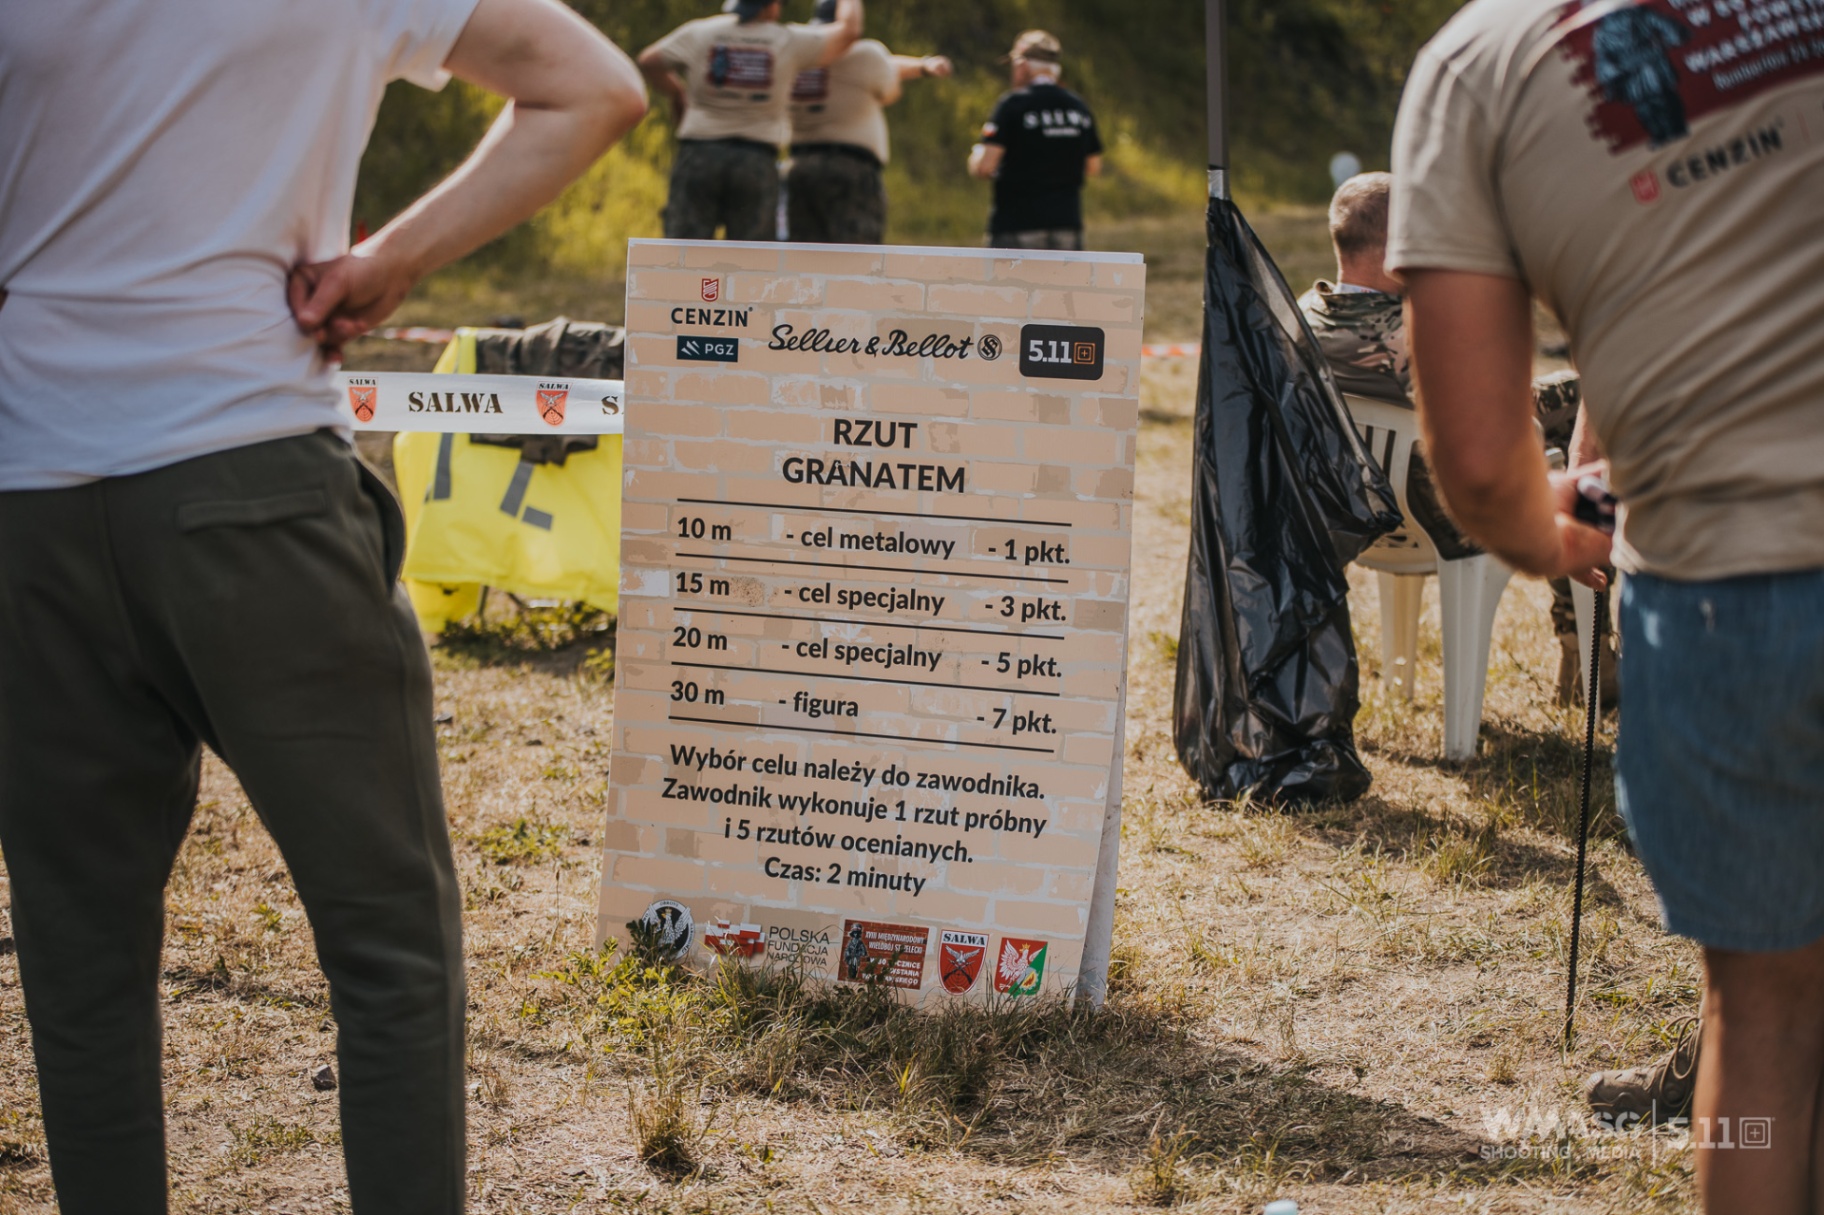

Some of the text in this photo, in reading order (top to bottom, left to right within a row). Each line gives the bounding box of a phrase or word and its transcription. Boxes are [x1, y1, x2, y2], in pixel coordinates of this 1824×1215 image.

[704, 343, 735, 356] PGZ
[767, 323, 975, 360] Sellier & Bellot
[1027, 339, 1073, 364] 5.11
[349, 378, 376, 386] SALWA
[538, 382, 570, 390] SALWA
[408, 391, 504, 414] SALWA
[833, 418, 918, 449] RZUT
[782, 456, 965, 494] GRANATEM
[677, 516, 706, 539] 10
[711, 524, 732, 541] m
[800, 526, 833, 548] cel
[839, 530, 956, 561] metalowy
[1004, 538, 1018, 561] 1
[1024, 540, 1070, 566] pkt.
[676, 571, 703, 594] 15
[709, 579, 730, 596] m
[798, 582, 831, 604] cel
[837, 586, 946, 617] specjalny
[1000, 595, 1015, 618] 3
[1021, 597, 1067, 623] pkt.
[672, 625, 702, 649] 20
[707, 633, 728, 651] m
[796, 637, 829, 659] cel
[834, 642, 943, 672] specjalny
[996, 651, 1011, 674] 5
[1017, 653, 1062, 679] pkt.
[670, 680, 699, 703] 30
[704, 688, 725, 706] m
[793, 690, 859, 719] figura
[992, 707, 1007, 729] 7
[1012, 710, 1057, 736] pkt.
[669, 743, 1045, 800] Wybór celu należy do zawodnika.
[661, 777, 1048, 839] Zawodnik wykonuje 1 rzut próbny
[724, 816, 973, 864] i 5 rzutów ocenianych.
[764, 856, 927, 898] Czas: 2 minuty
[769, 926, 830, 945] POLSKA
[942, 933, 986, 946] SALWA
